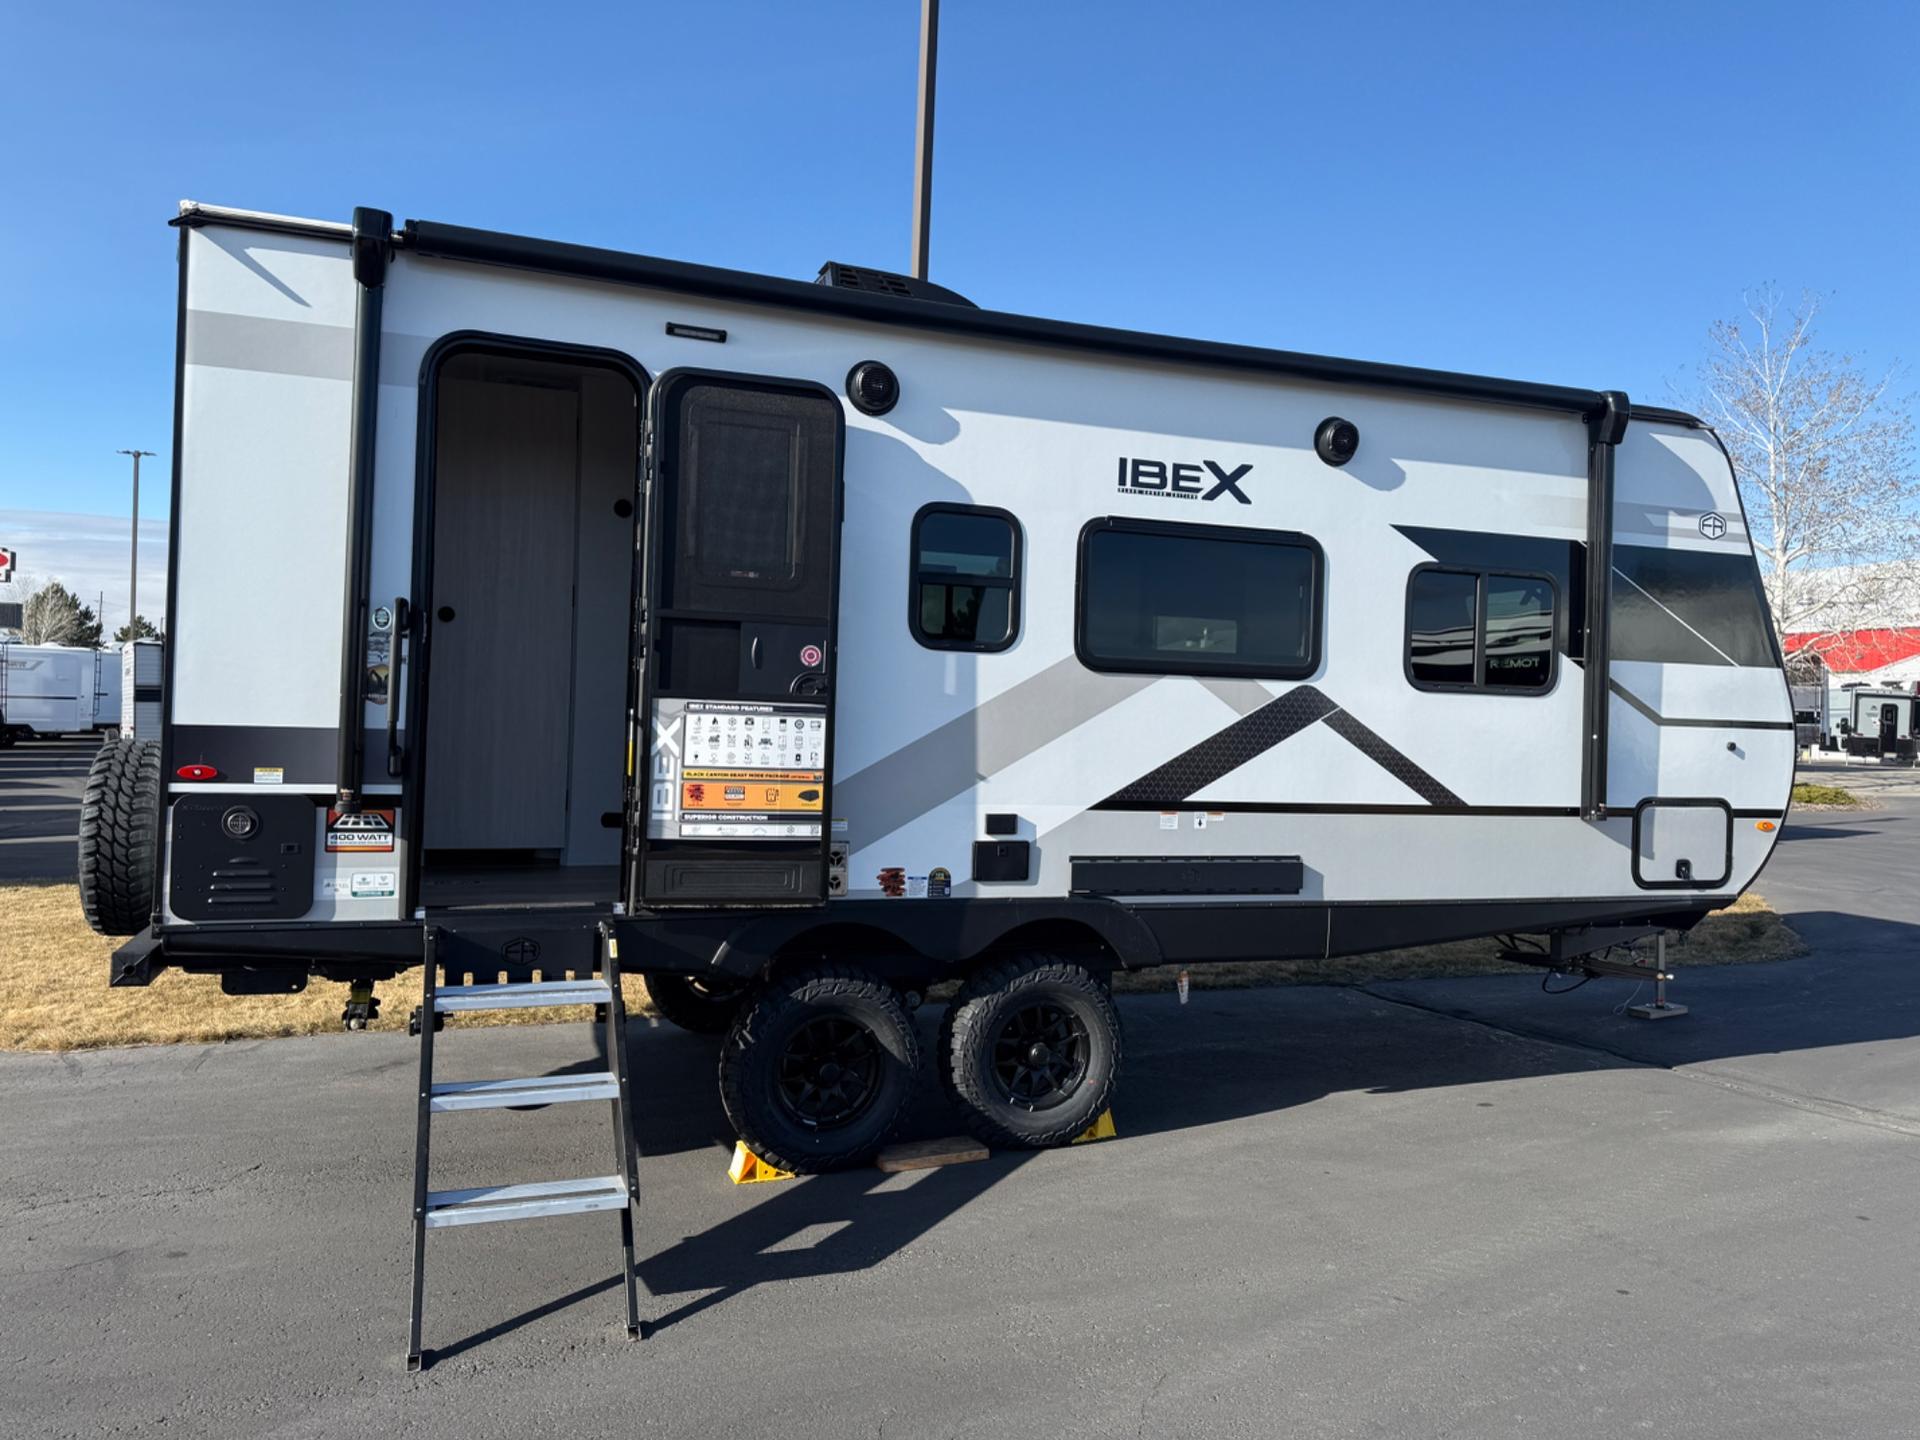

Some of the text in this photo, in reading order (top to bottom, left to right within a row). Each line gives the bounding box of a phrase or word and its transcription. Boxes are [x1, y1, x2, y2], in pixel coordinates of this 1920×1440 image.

[1118, 457, 1254, 505] IBEX
[651, 716, 681, 820] IBEX
[330, 833, 389, 841] 400 WATT
